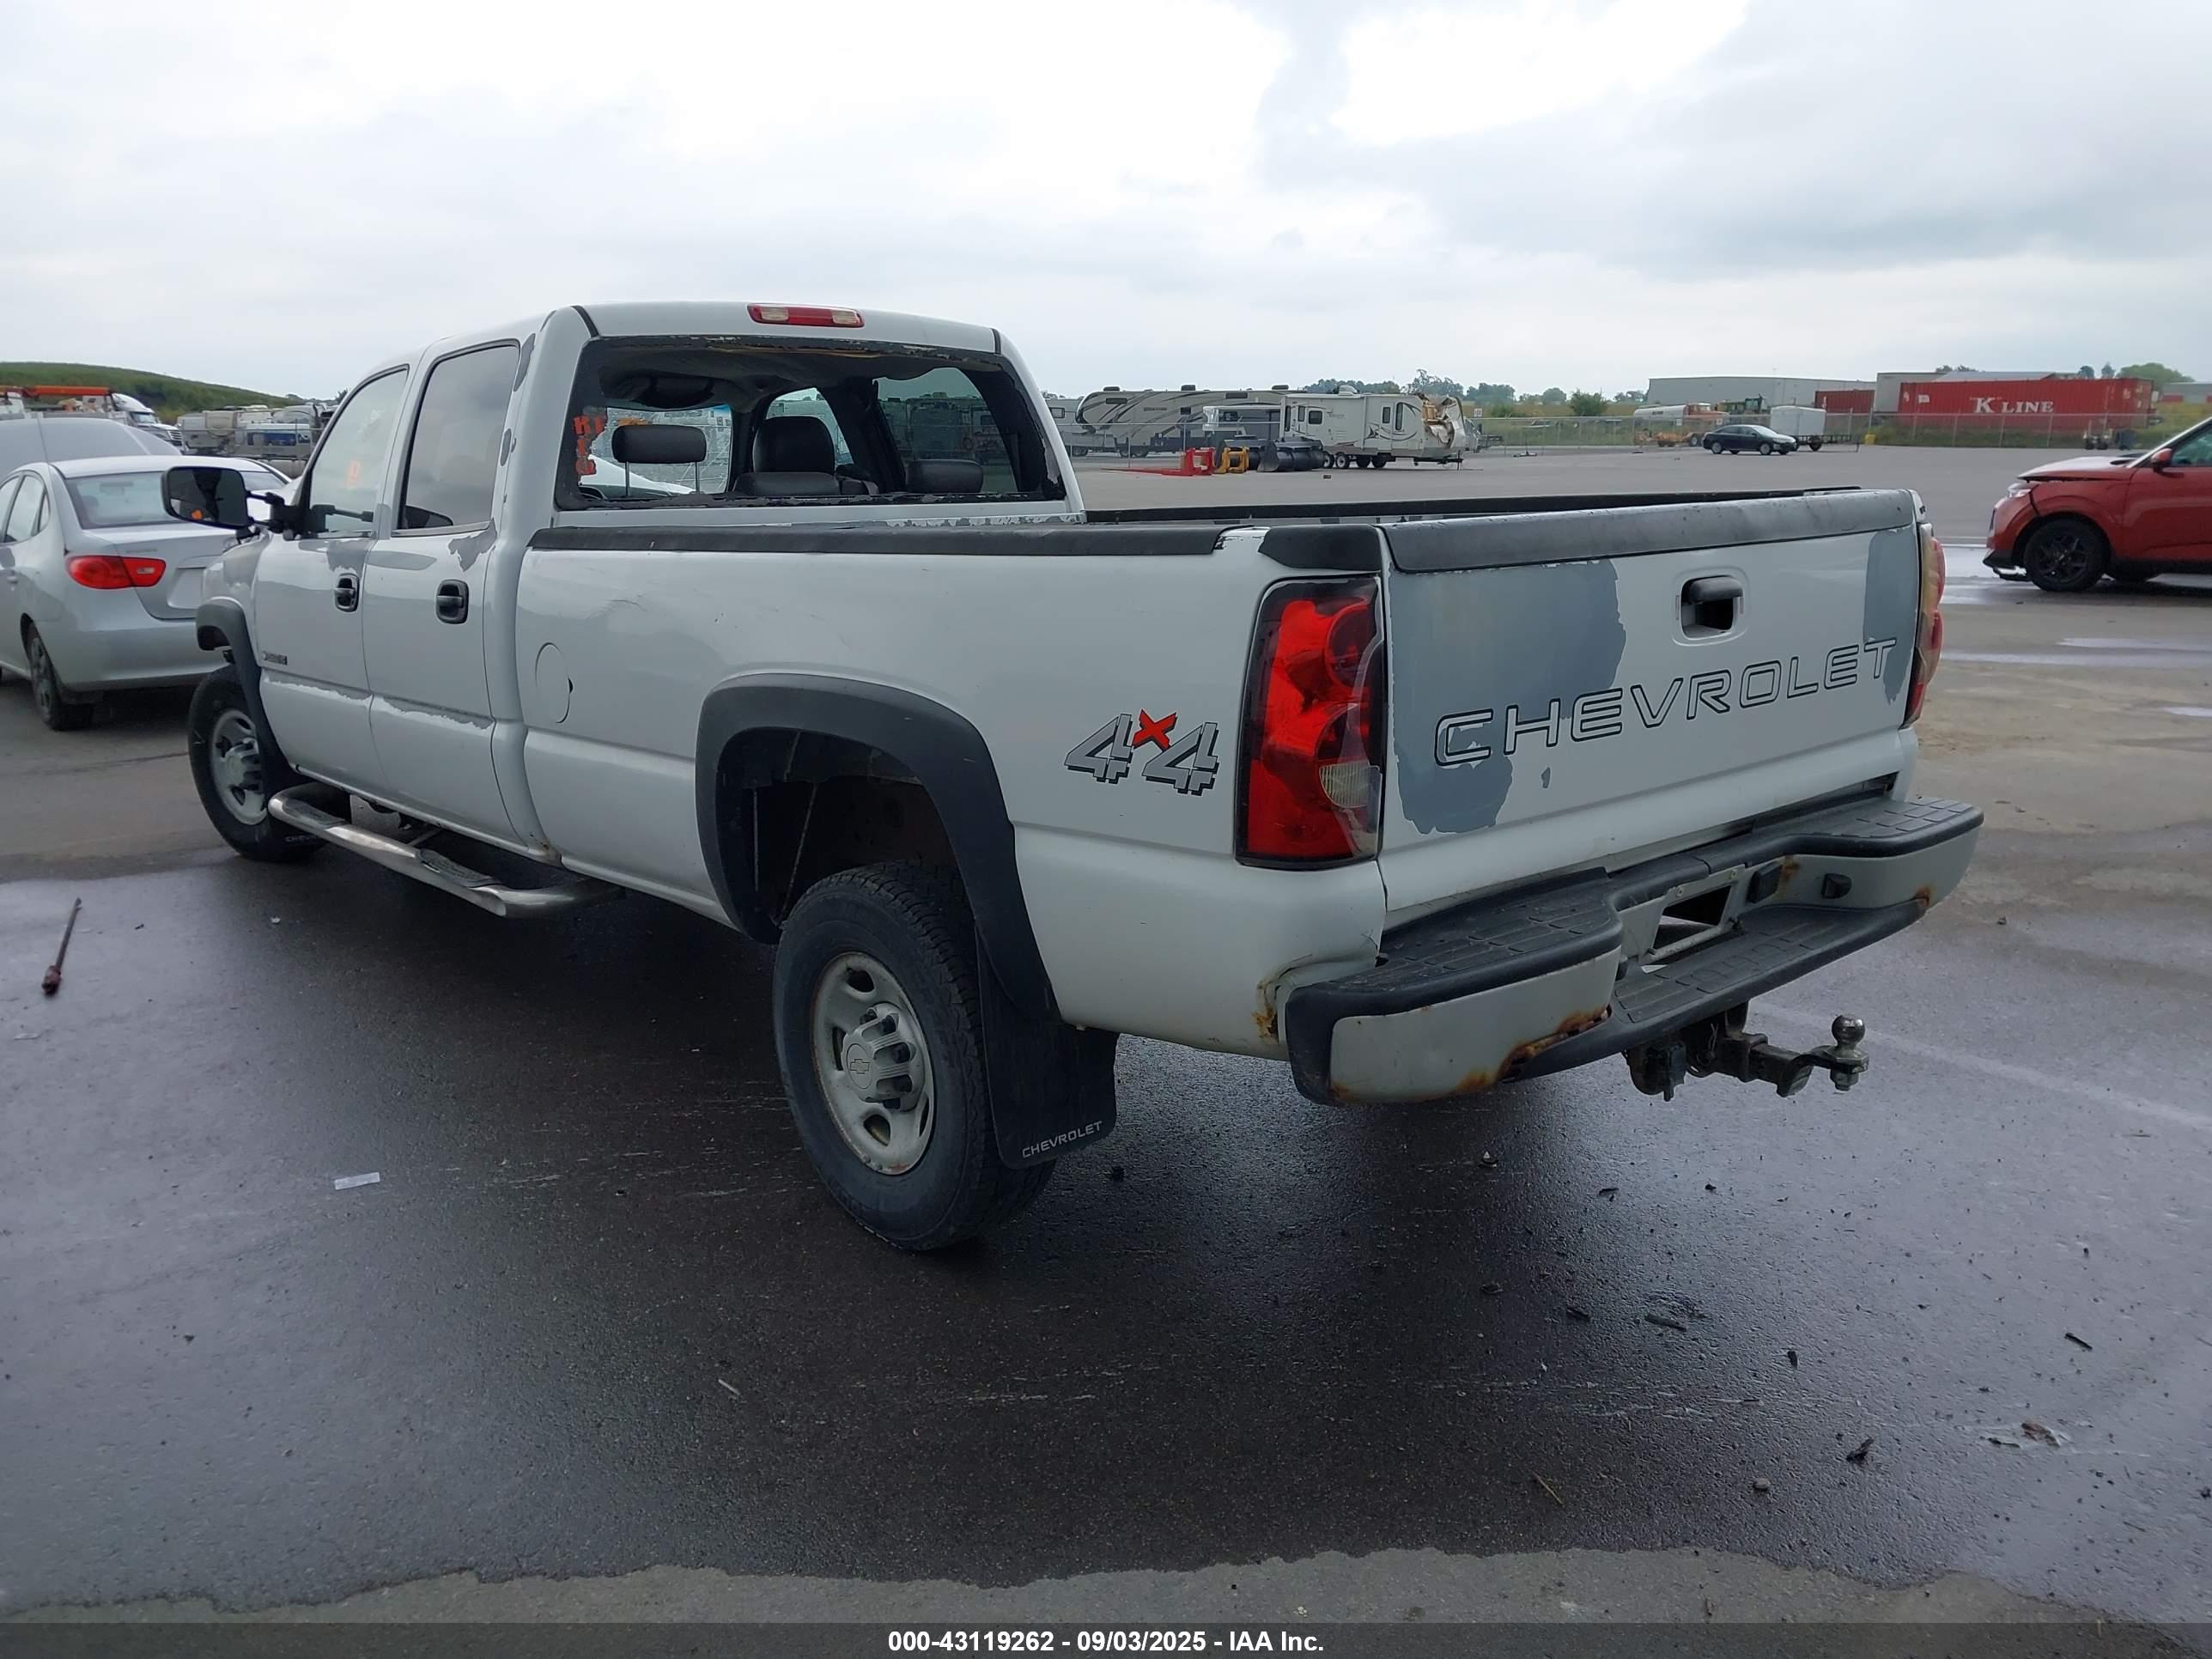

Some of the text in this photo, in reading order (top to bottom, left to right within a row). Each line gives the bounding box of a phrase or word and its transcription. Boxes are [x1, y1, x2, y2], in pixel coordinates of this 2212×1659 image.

[2002, 401, 2054, 413] LINE
[1434, 638, 1897, 767] CHEVROLET
[1022, 1121, 1103, 1158] CHEVROLET
